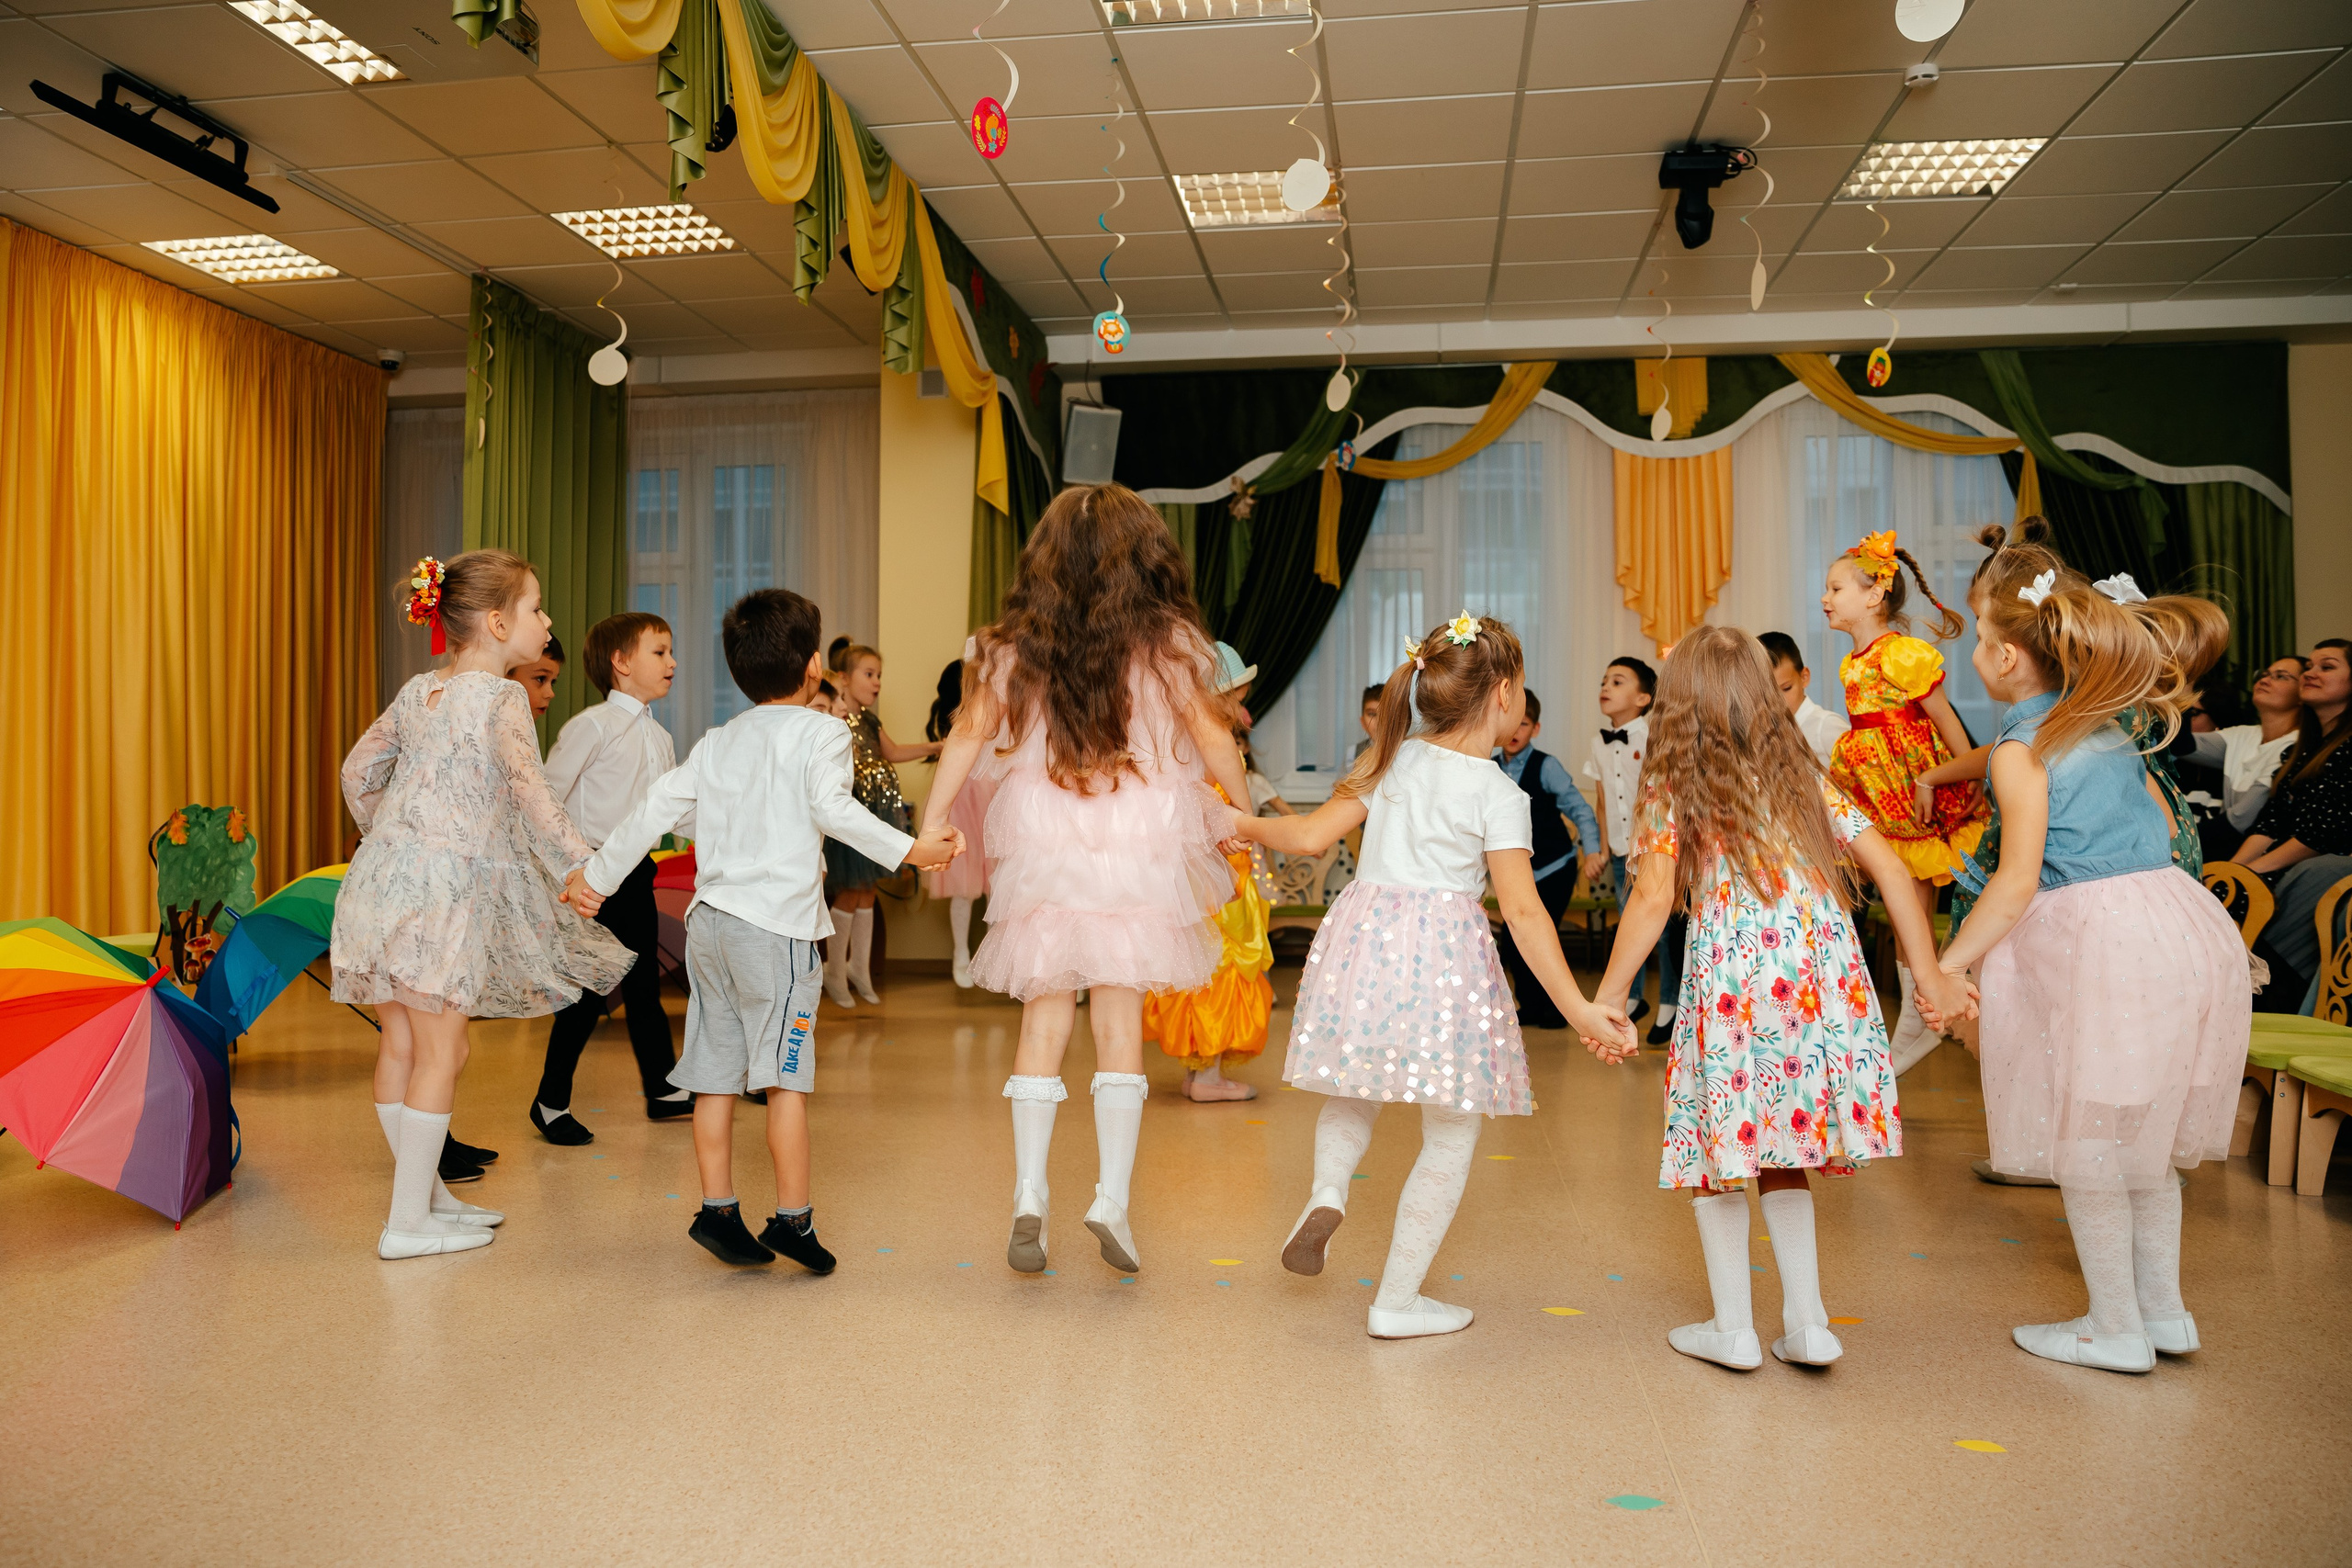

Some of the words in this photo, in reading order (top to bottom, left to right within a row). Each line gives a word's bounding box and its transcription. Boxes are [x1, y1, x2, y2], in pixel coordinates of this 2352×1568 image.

[412, 27, 441, 45] SONY
[790, 1010, 811, 1038] RIDE
[787, 1038, 804, 1047] A
[781, 1046, 799, 1074] TAKE
